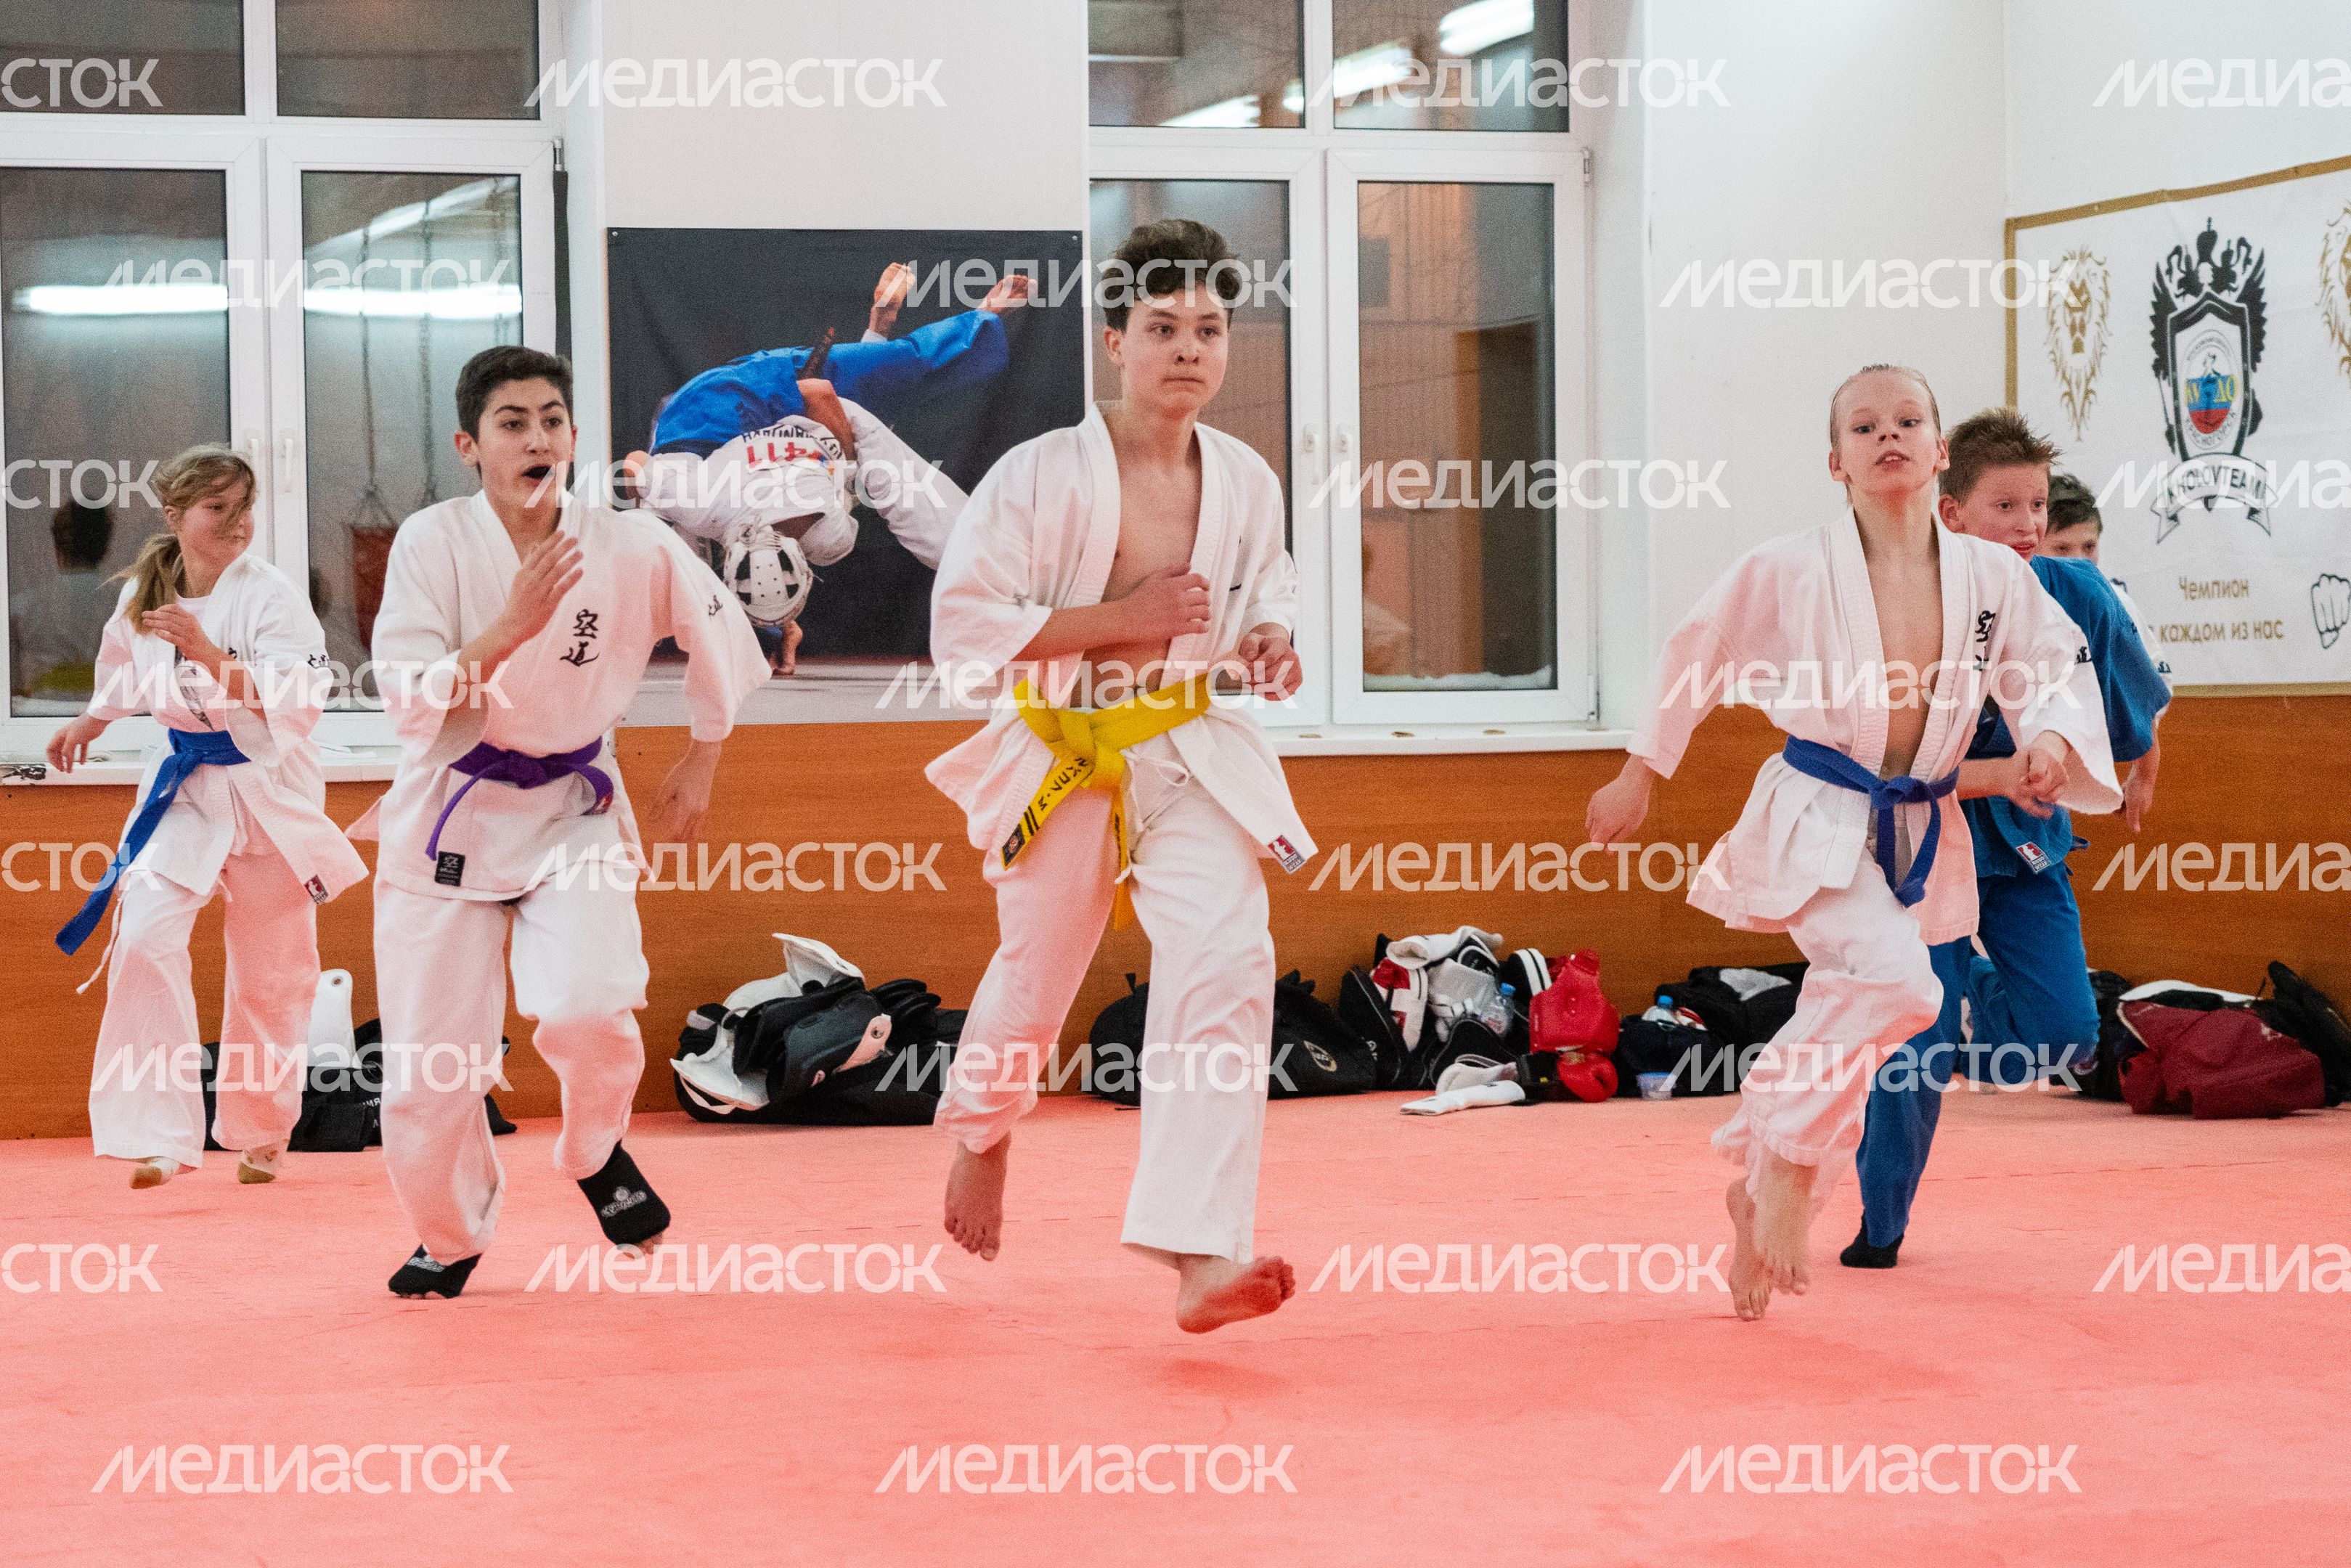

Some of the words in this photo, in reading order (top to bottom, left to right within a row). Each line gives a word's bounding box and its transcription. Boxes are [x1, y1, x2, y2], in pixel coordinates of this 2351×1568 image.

[2179, 576, 2249, 600] Чемпион
[2160, 623, 2225, 644] каждом
[2230, 621, 2248, 640] из
[2253, 619, 2284, 640] нас
